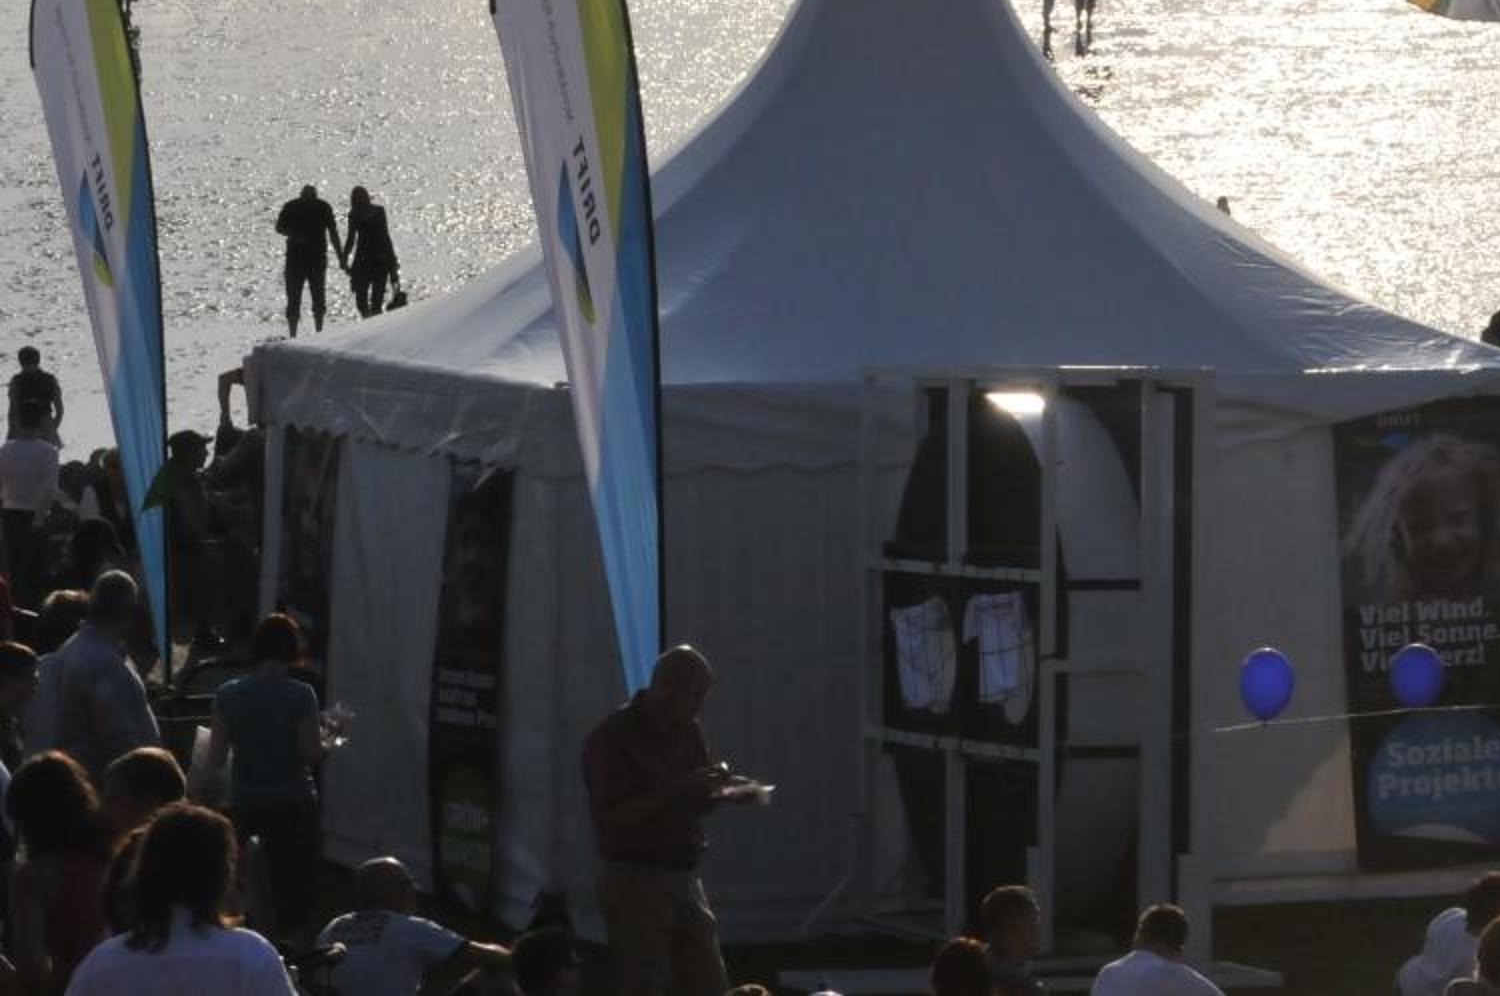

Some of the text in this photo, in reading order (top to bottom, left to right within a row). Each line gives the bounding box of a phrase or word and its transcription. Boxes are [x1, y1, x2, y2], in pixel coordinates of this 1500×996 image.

[1360, 596, 1490, 626] Viel Wind.
[1360, 625, 1409, 651] Viel
[1360, 642, 1486, 672] Vi erz!
